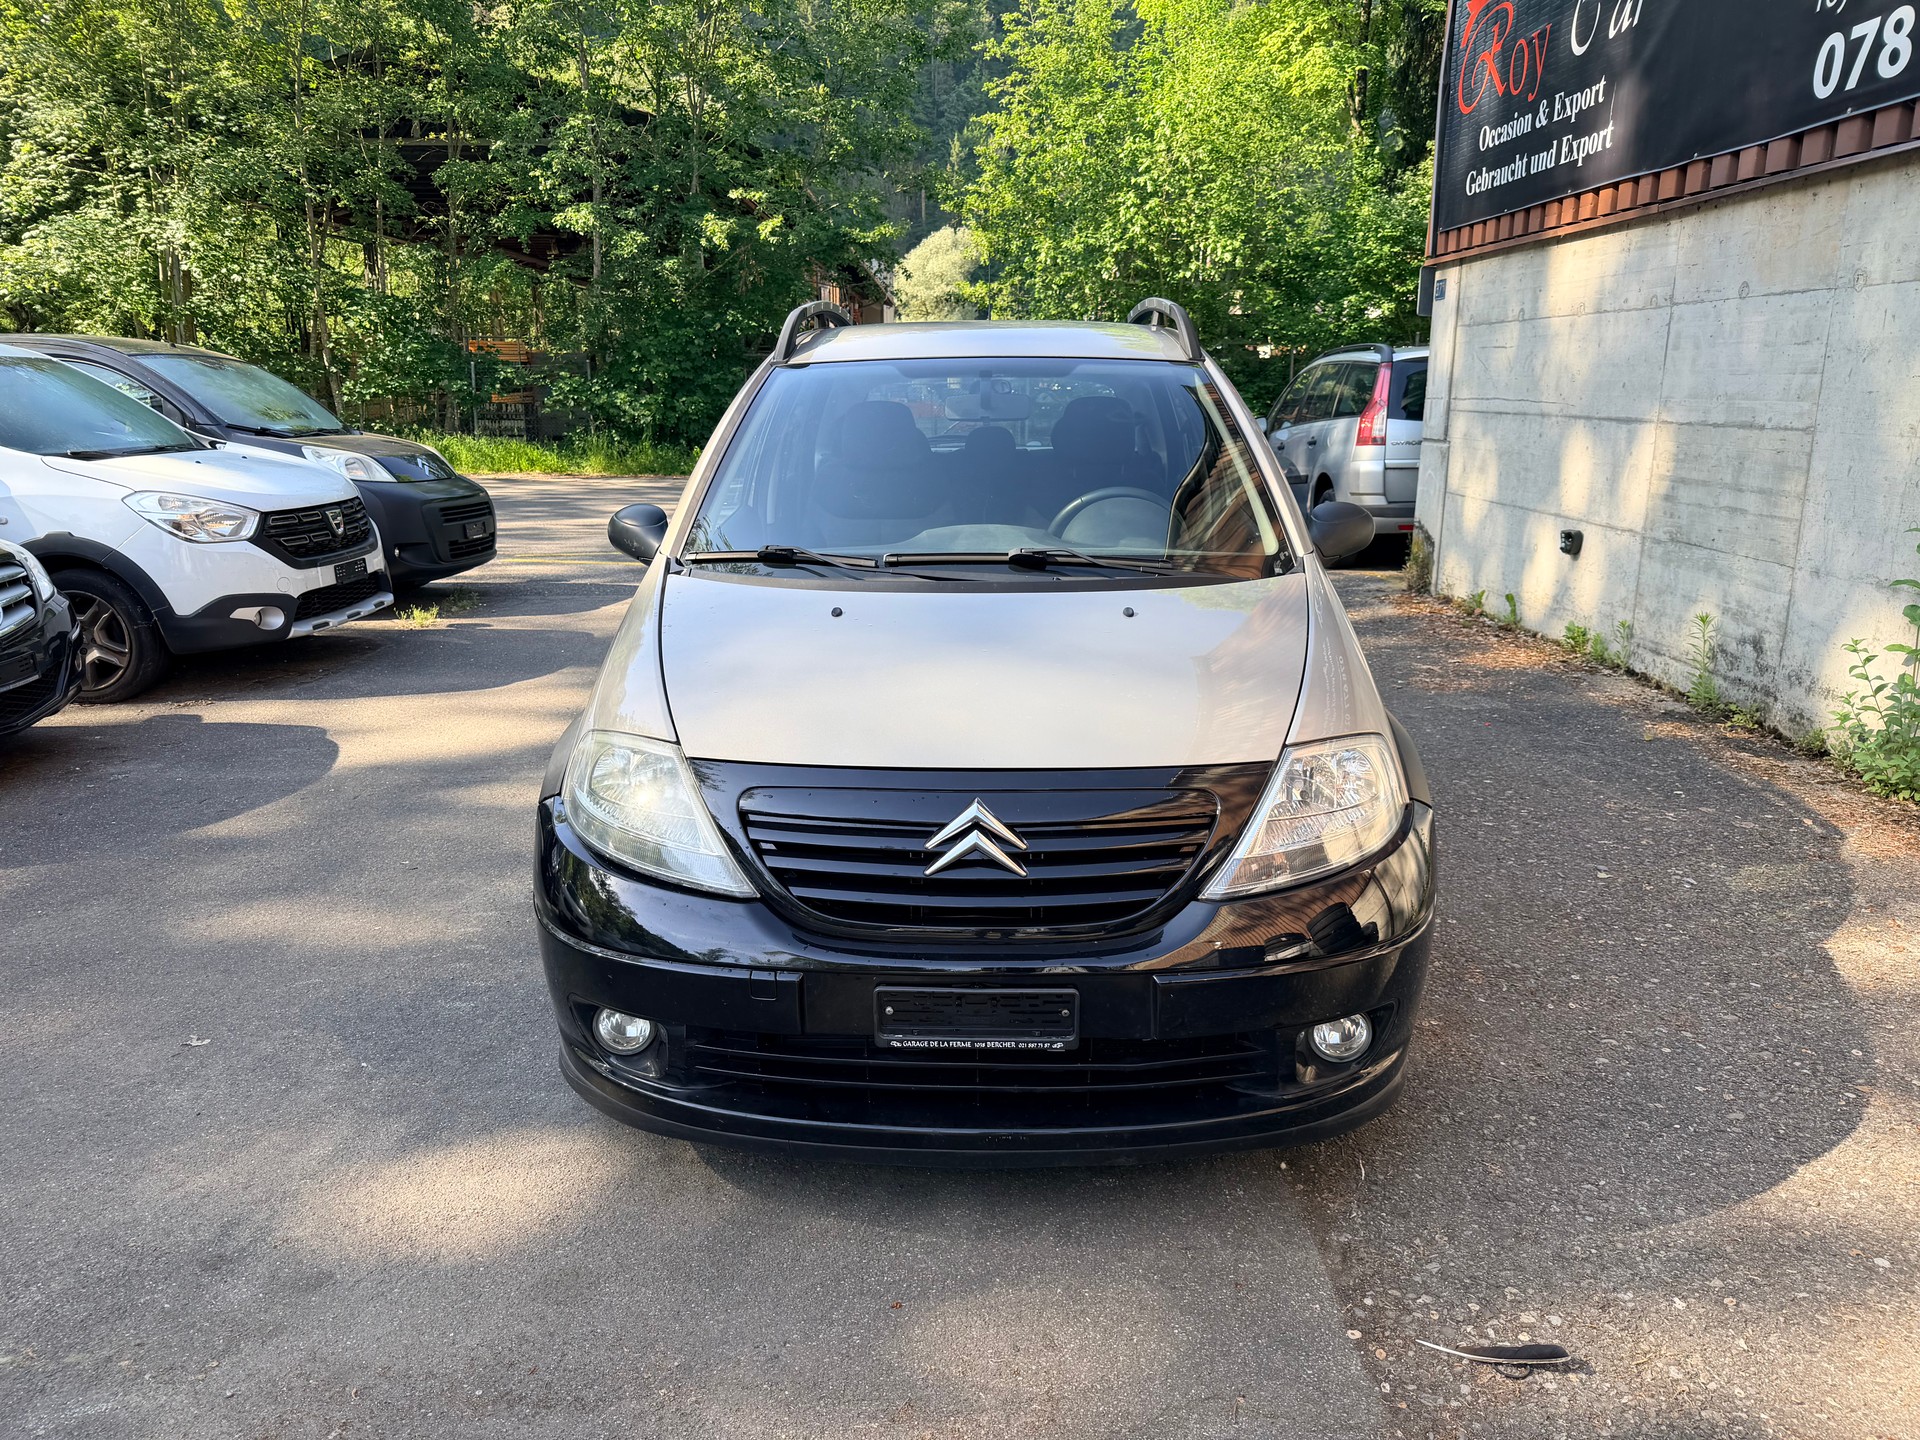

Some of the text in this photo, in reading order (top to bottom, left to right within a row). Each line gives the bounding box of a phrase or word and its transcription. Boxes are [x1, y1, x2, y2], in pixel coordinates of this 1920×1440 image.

[1458, 1, 1553, 115] Roy
[1813, 5, 1916, 99] 078
[1479, 75, 1607, 151] Occasion & Export
[1465, 119, 1614, 196] Gebraucht und Export
